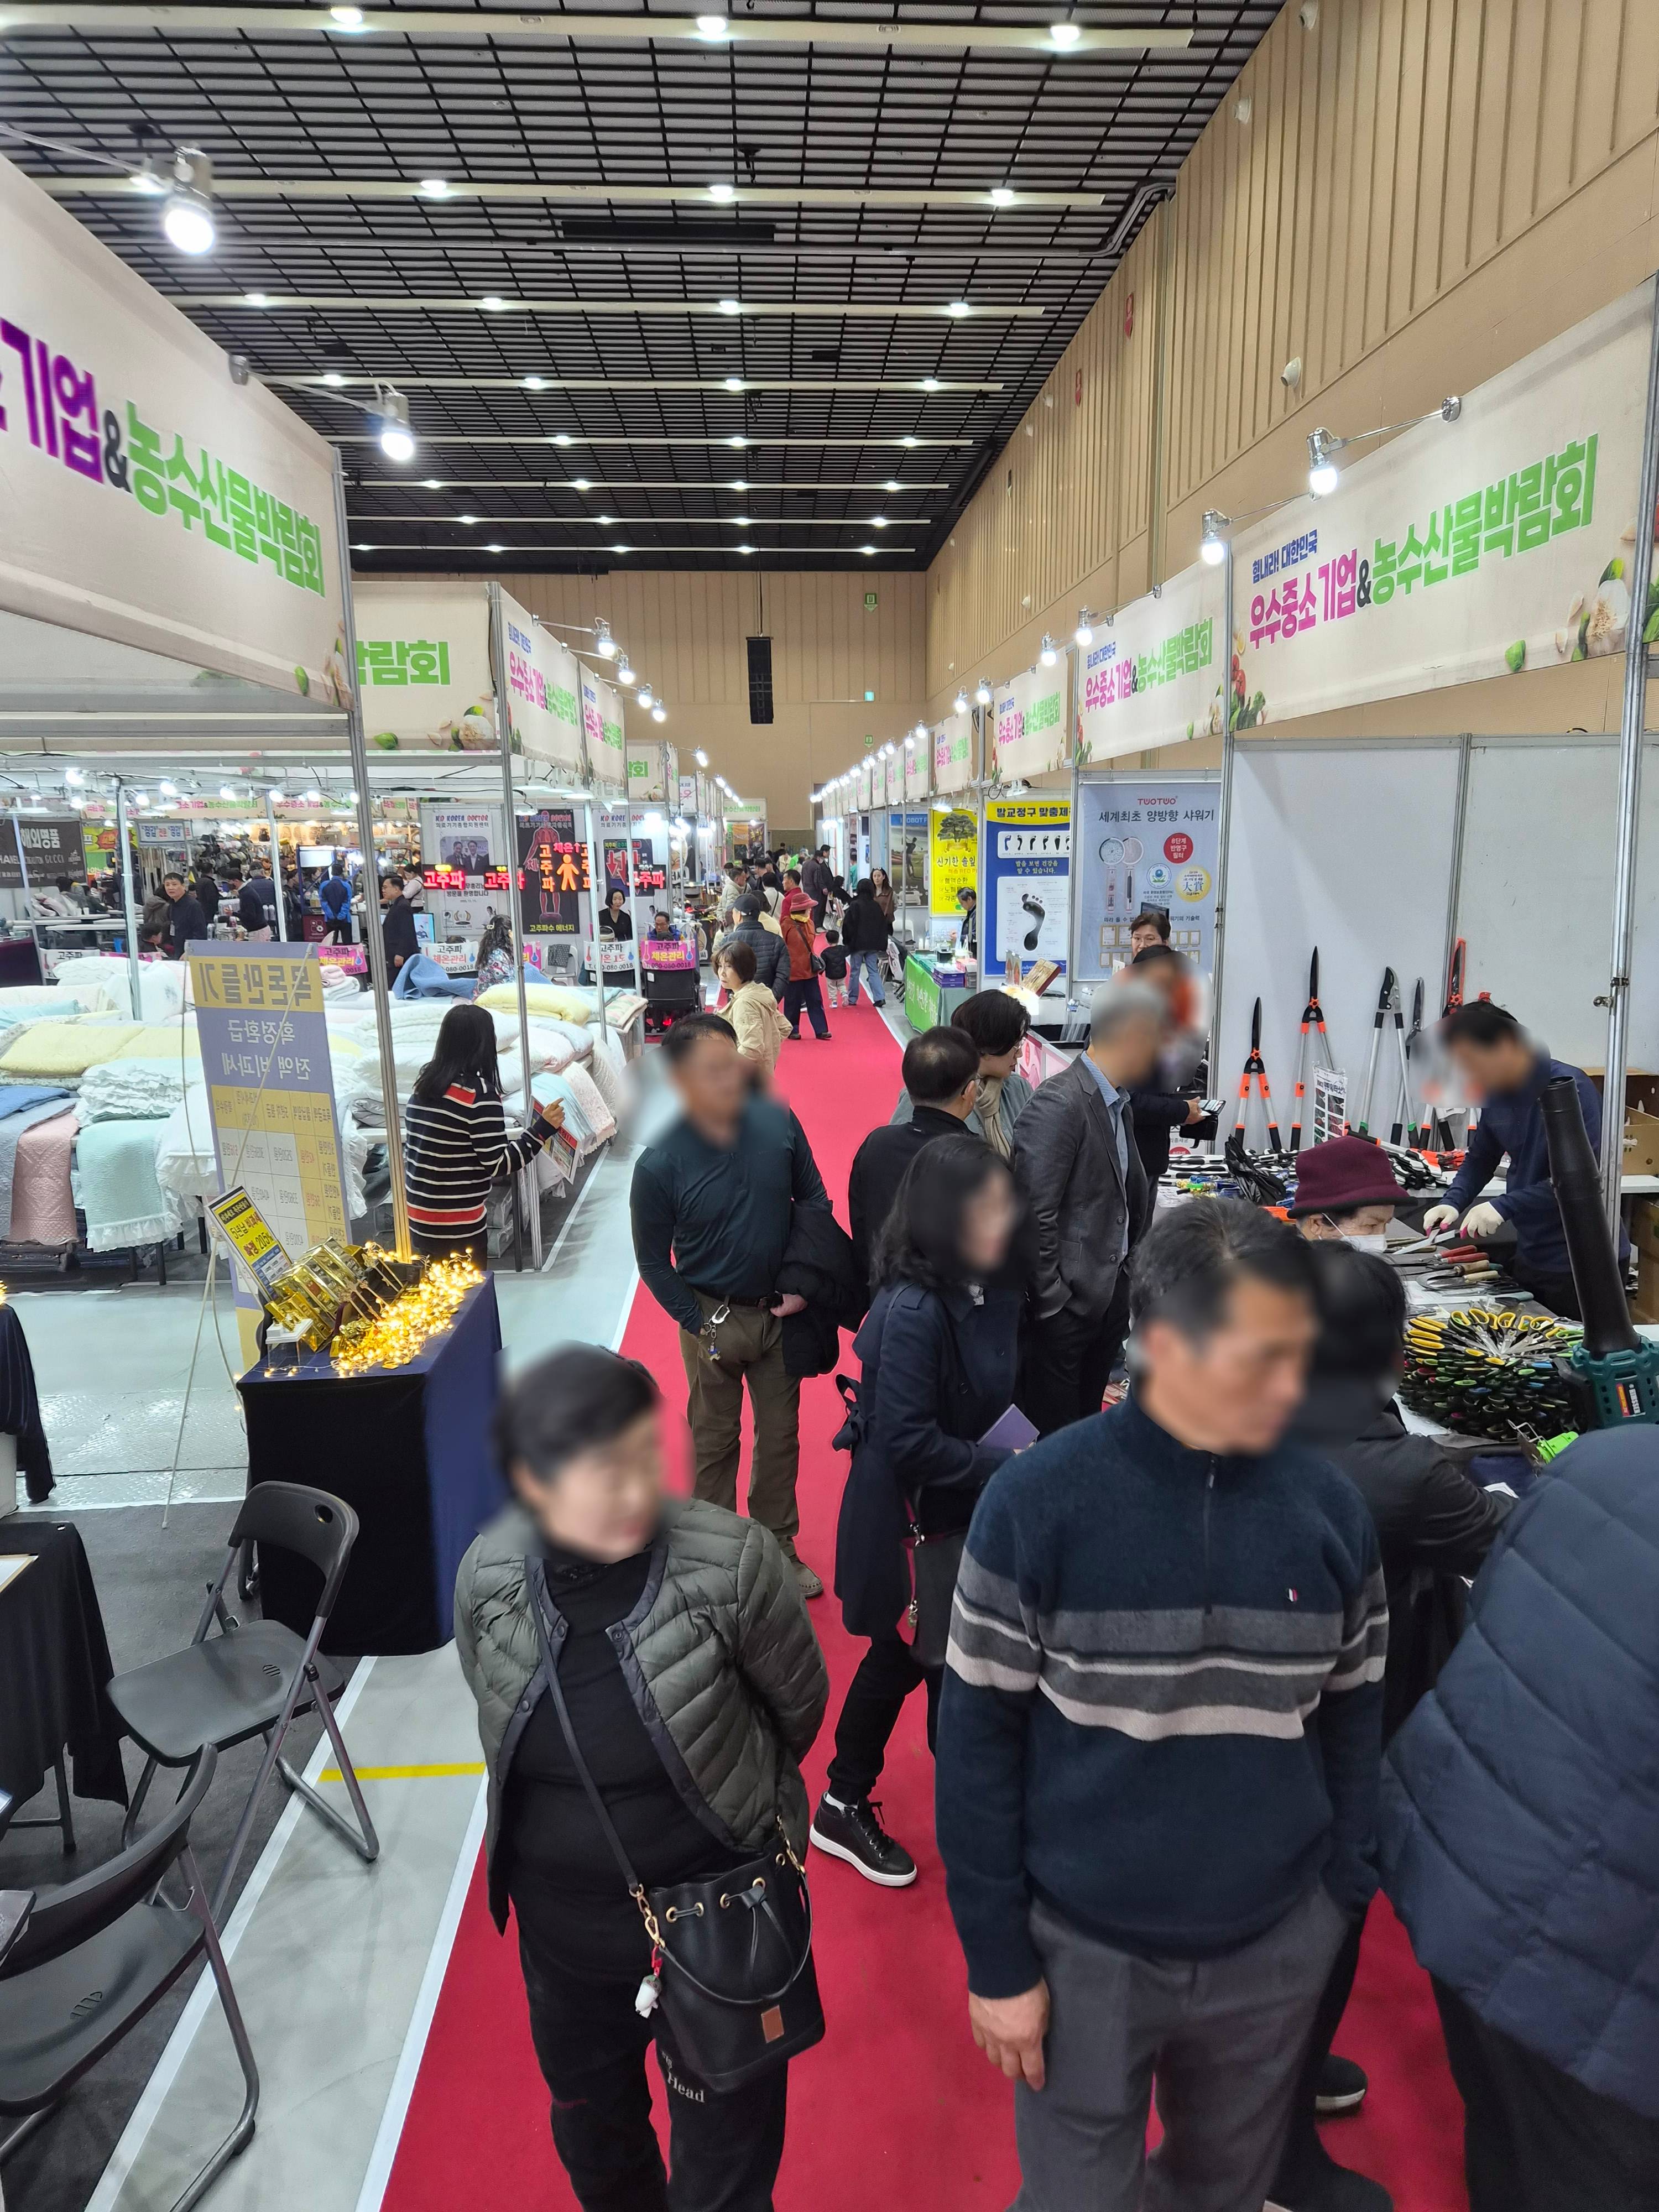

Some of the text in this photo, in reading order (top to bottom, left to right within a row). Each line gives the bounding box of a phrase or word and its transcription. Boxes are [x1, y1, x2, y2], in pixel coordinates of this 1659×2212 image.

[1252, 529, 1318, 584] 힘내라! 대한민국
[1138, 797, 1176, 806] TWOTWO
[997, 807, 1071, 818] 발교정구 맞춤제
[1099, 809, 1214, 823] 세계최초 양방향 샤워기
[20, 828, 60, 849] 해외명품
[937, 856, 975, 867] 신기한 솔잎
[424, 870, 464, 889] 고주파
[325, 947, 350, 957] 고주파
[437, 945, 462, 953] 고주파
[656, 942, 680, 952] 고주파
[433, 954, 466, 964] 체온관리
[614, 954, 626, 962] 1도
[651, 951, 685, 961] 체온관리
[319, 957, 354, 967] 체온관리
[255, 1232, 274, 1250] 205%
[667, 2072, 705, 2103] Head
